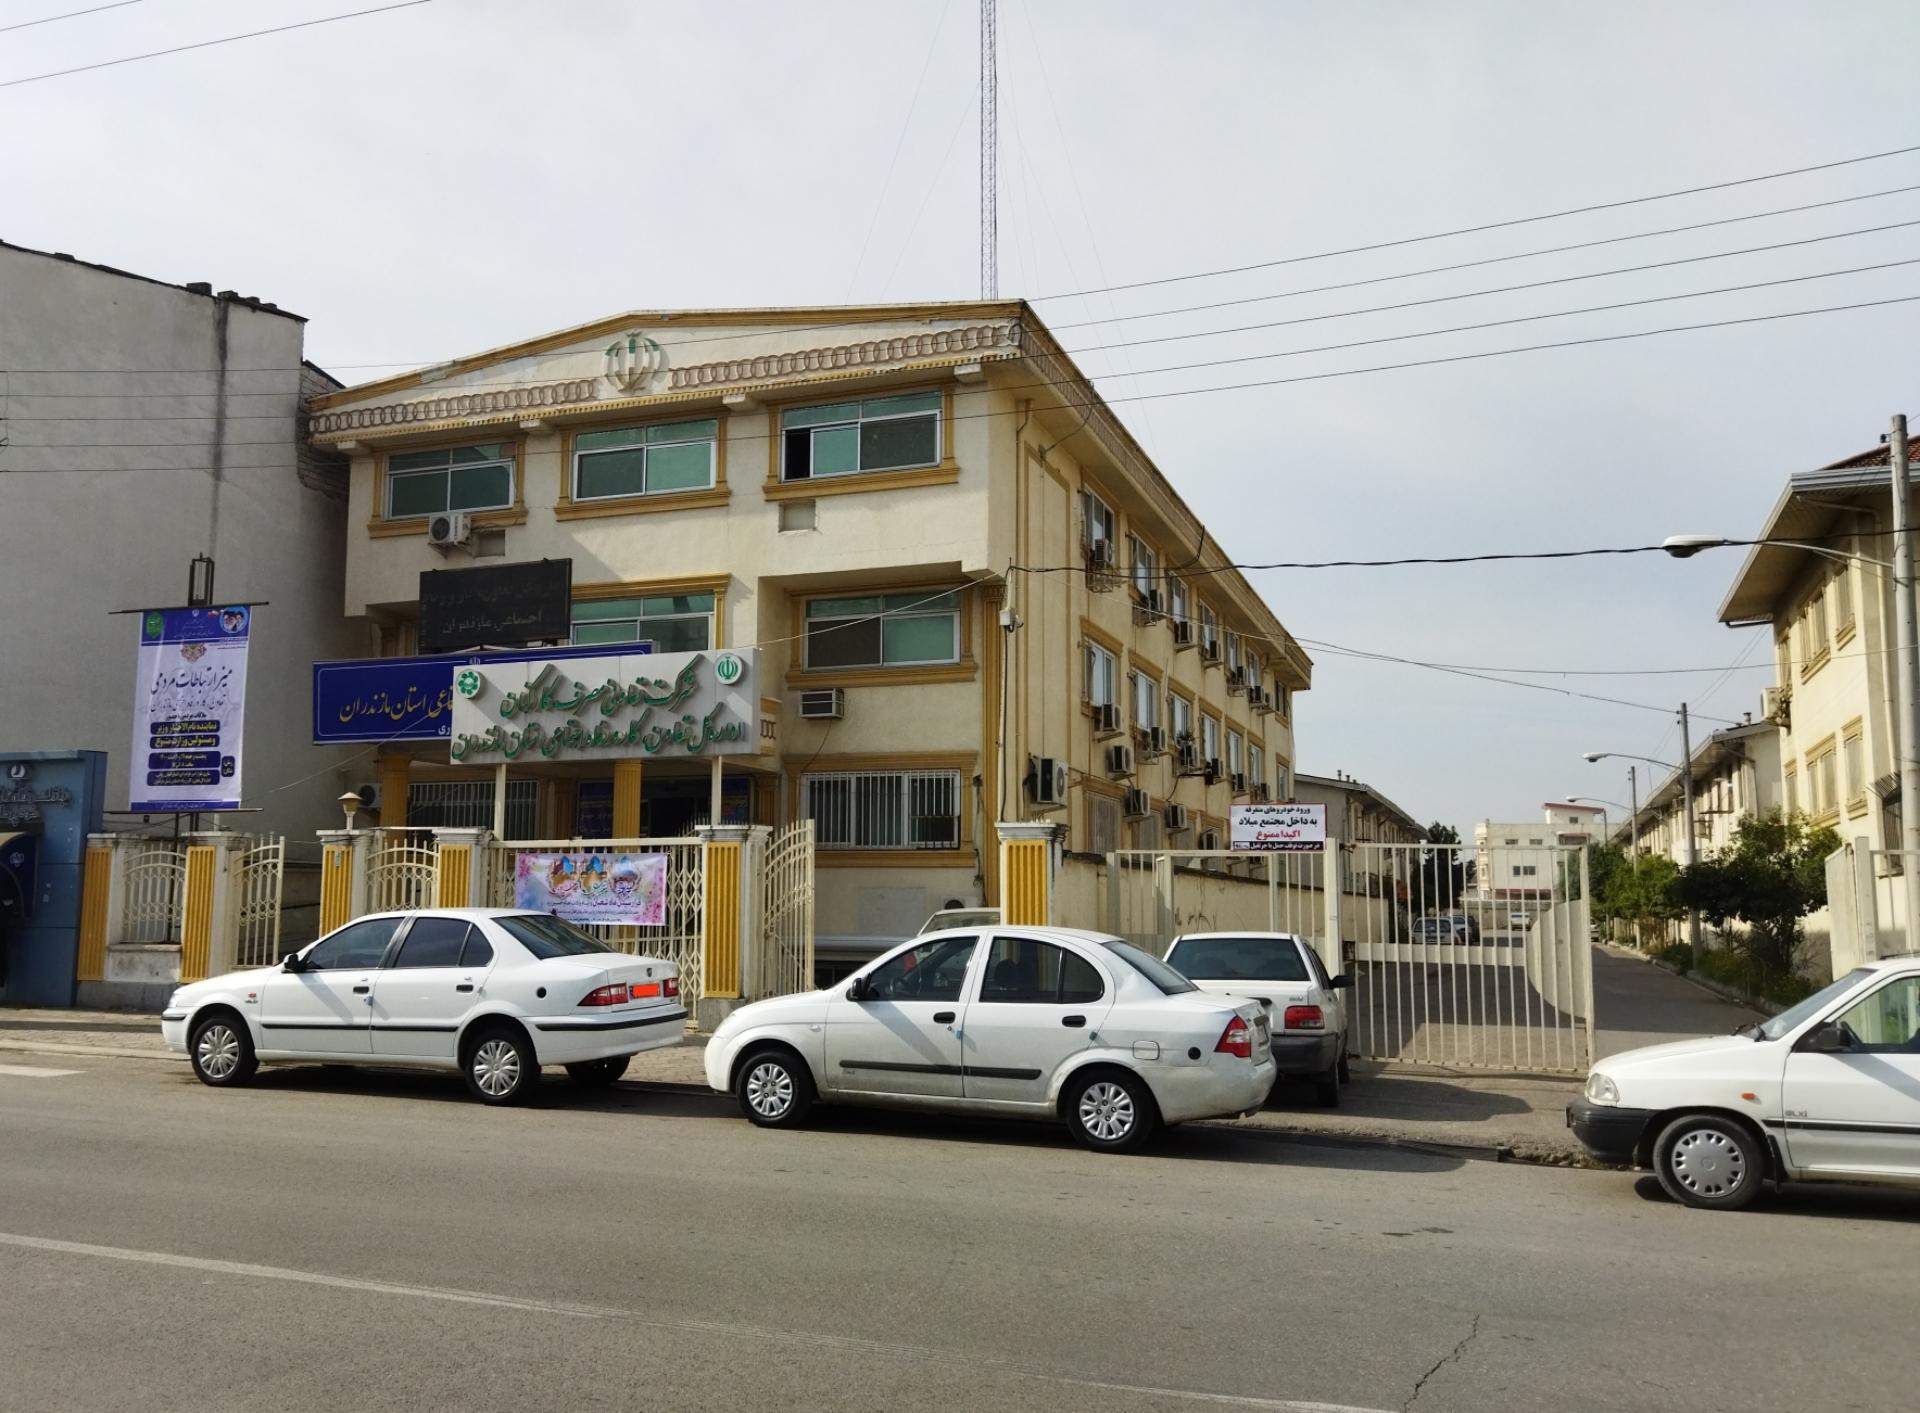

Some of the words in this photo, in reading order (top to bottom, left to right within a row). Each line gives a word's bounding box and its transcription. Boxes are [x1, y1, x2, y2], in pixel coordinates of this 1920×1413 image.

[150, 672, 176, 695] مردمی
[176, 667, 217, 694] ارتباطات
[213, 666, 233, 692] میز
[500, 663, 566, 718] کارکنان
[643, 653, 706, 713] شرکت
[338, 691, 392, 722] مازندران
[390, 686, 427, 721] استان
[550, 680, 610, 716] مصرف
[600, 676, 650, 716] تعاونی
[451, 725, 505, 760] مازندران
[504, 722, 542, 760] استان
[1238, 816, 1258, 828] میلاد
[1245, 806, 1263, 815] متفرقه
[1259, 817, 1286, 828] مجتمع
[1263, 806, 1296, 815] خودروهای
[1286, 816, 1309, 828] داخل
[1296, 806, 1311, 815] ورود
[1309, 818, 1318, 828] به
[1256, 830, 1280, 841] ممنوع
[1785, 1110, 1808, 1118] GLXi
